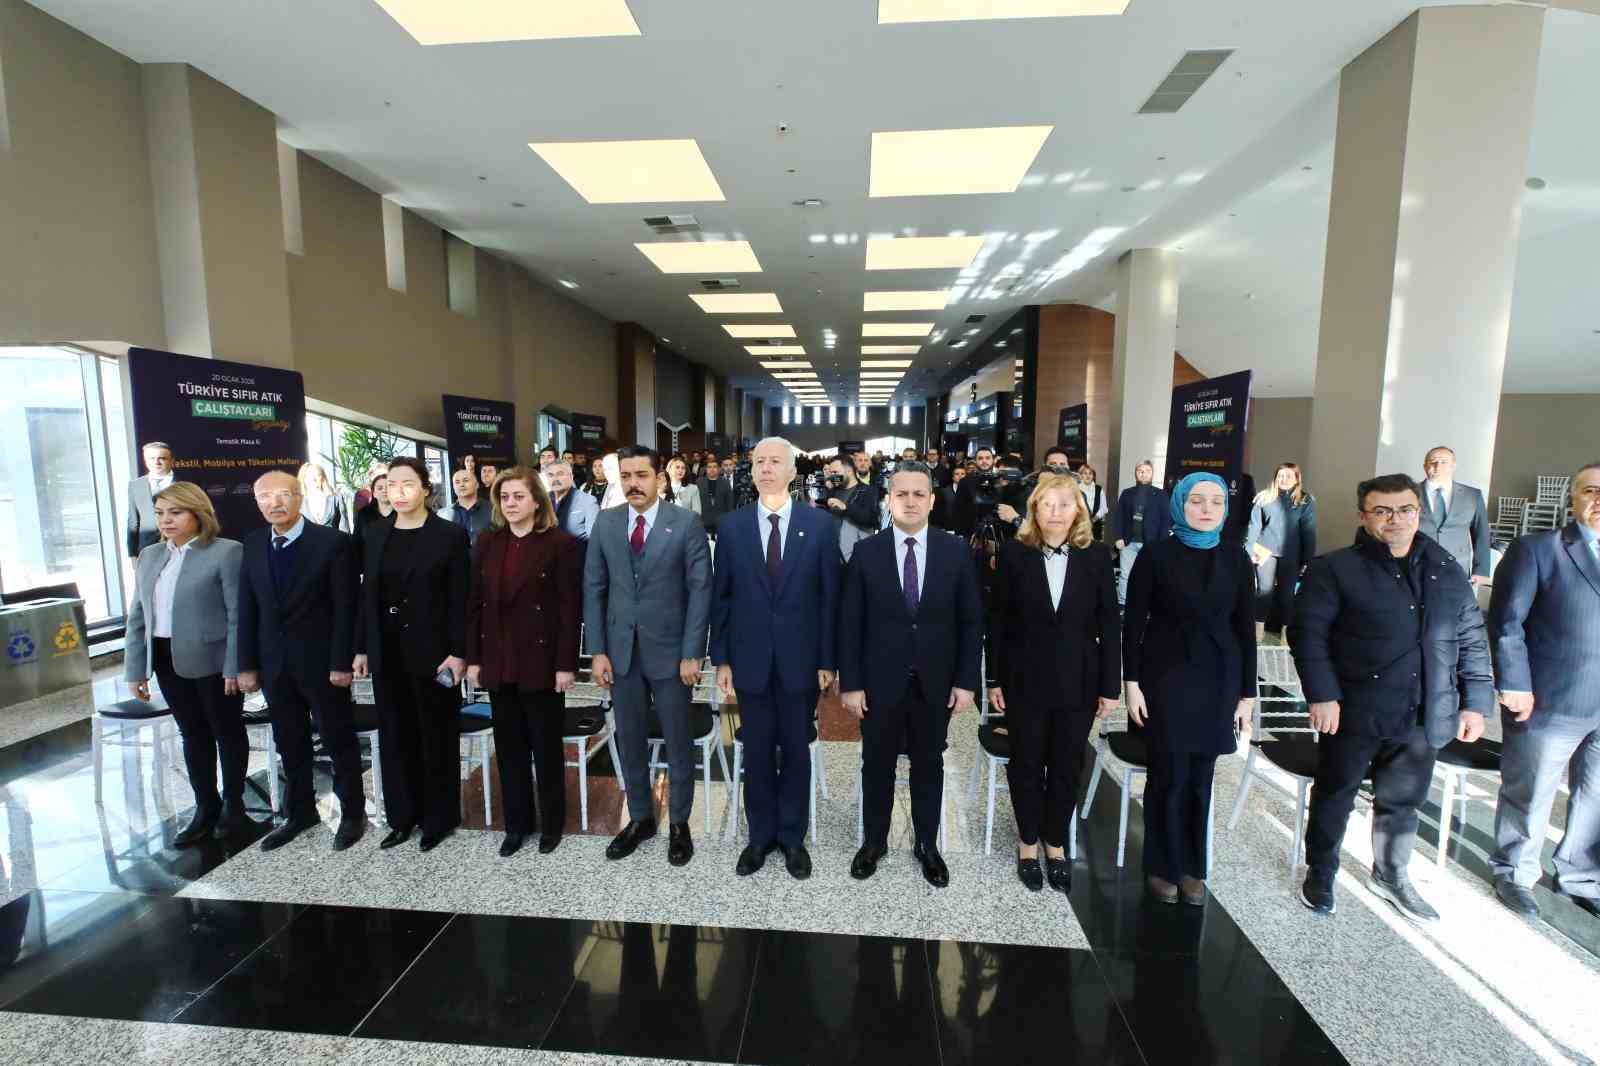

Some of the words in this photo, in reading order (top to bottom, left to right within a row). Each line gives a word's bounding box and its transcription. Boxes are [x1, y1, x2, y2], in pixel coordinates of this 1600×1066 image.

[177, 382, 229, 398] TÜRKİYE
[231, 389, 258, 401] SIFIR
[261, 392, 283, 403] ATIK
[195, 402, 272, 418] ÇALIŞTAYLARI
[1184, 400, 1204, 412] TÜRKİYE
[1204, 399, 1219, 410] SIFIR
[1219, 397, 1233, 408] ATIK
[172, 458, 201, 469] ekstil,
